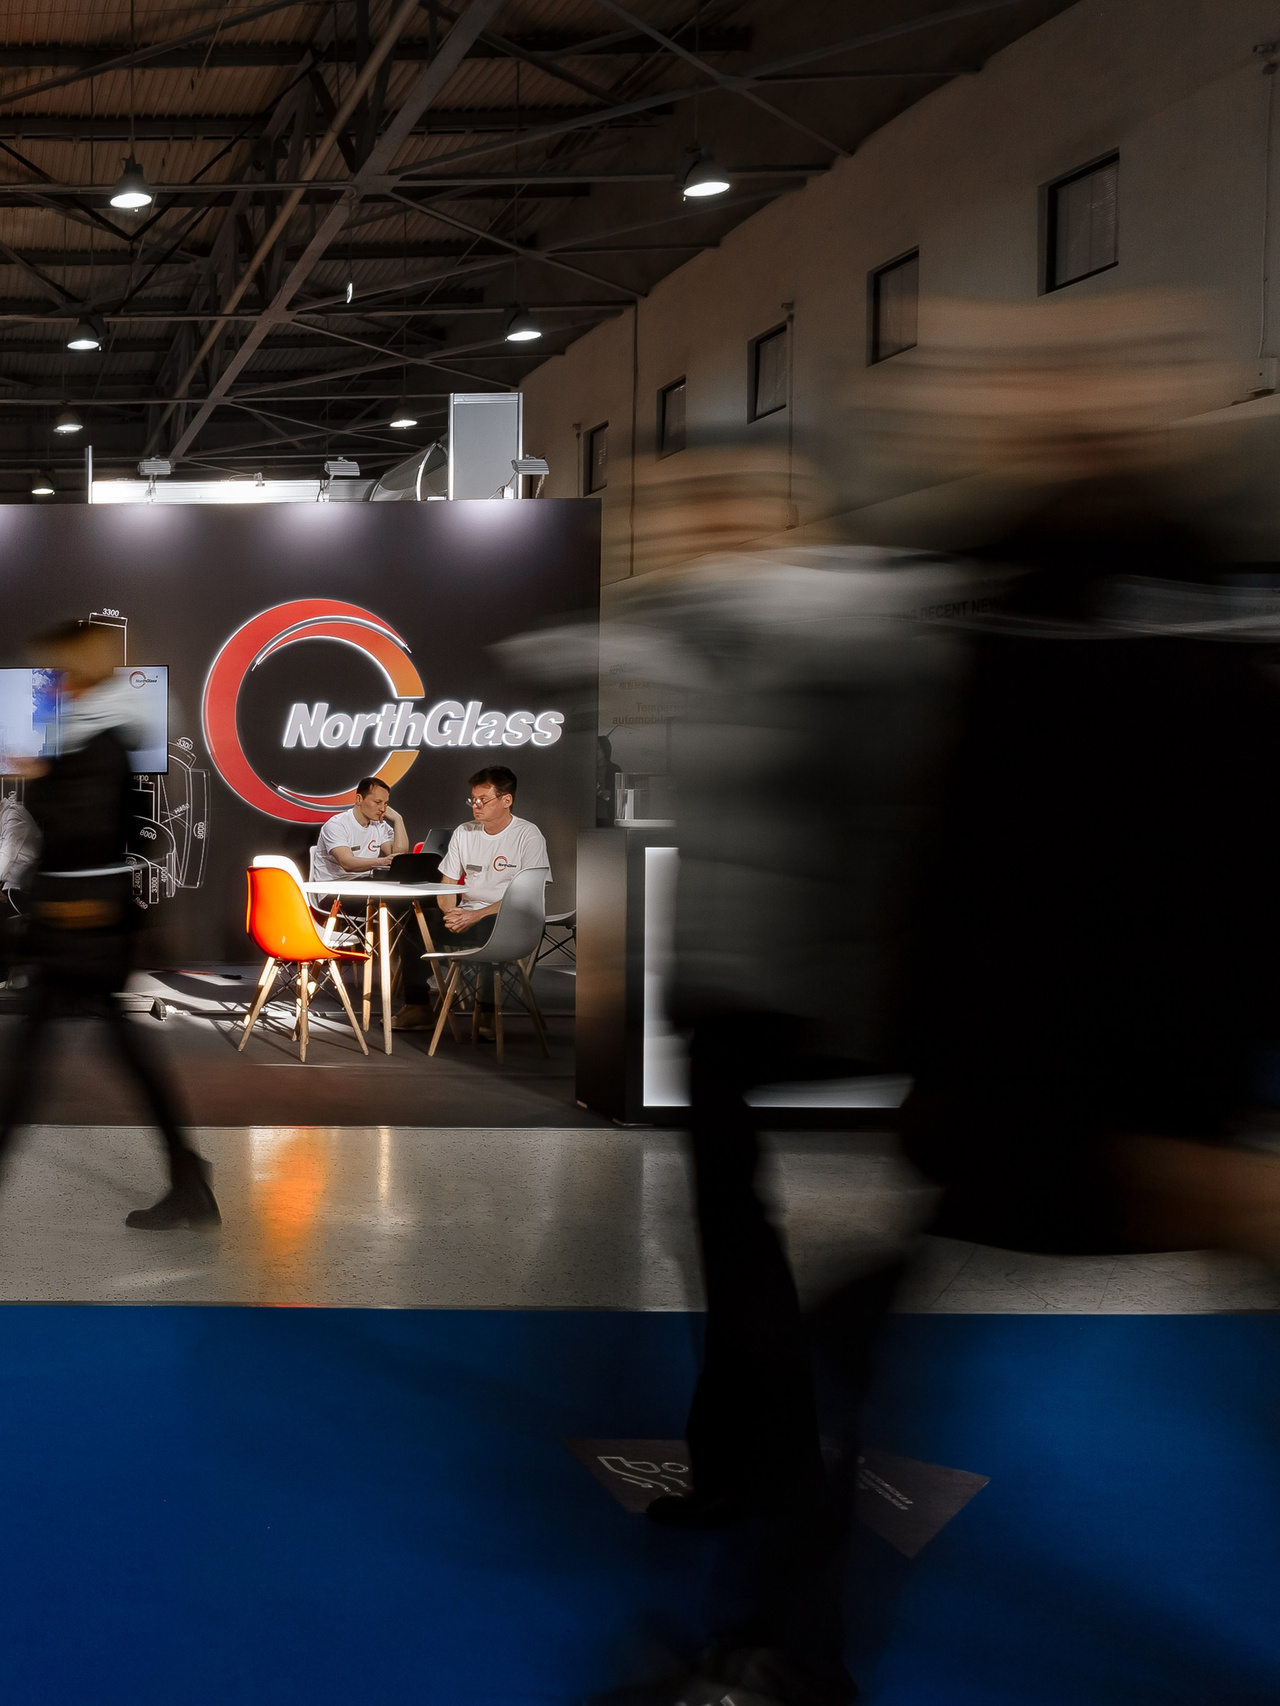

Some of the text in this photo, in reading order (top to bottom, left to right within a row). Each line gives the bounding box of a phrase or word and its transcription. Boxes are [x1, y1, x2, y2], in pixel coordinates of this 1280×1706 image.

[102, 607, 120, 617] 3300
[281, 699, 566, 749] NorthGlass
[176, 738, 194, 751] 3300
[139, 829, 157, 840] 8000
